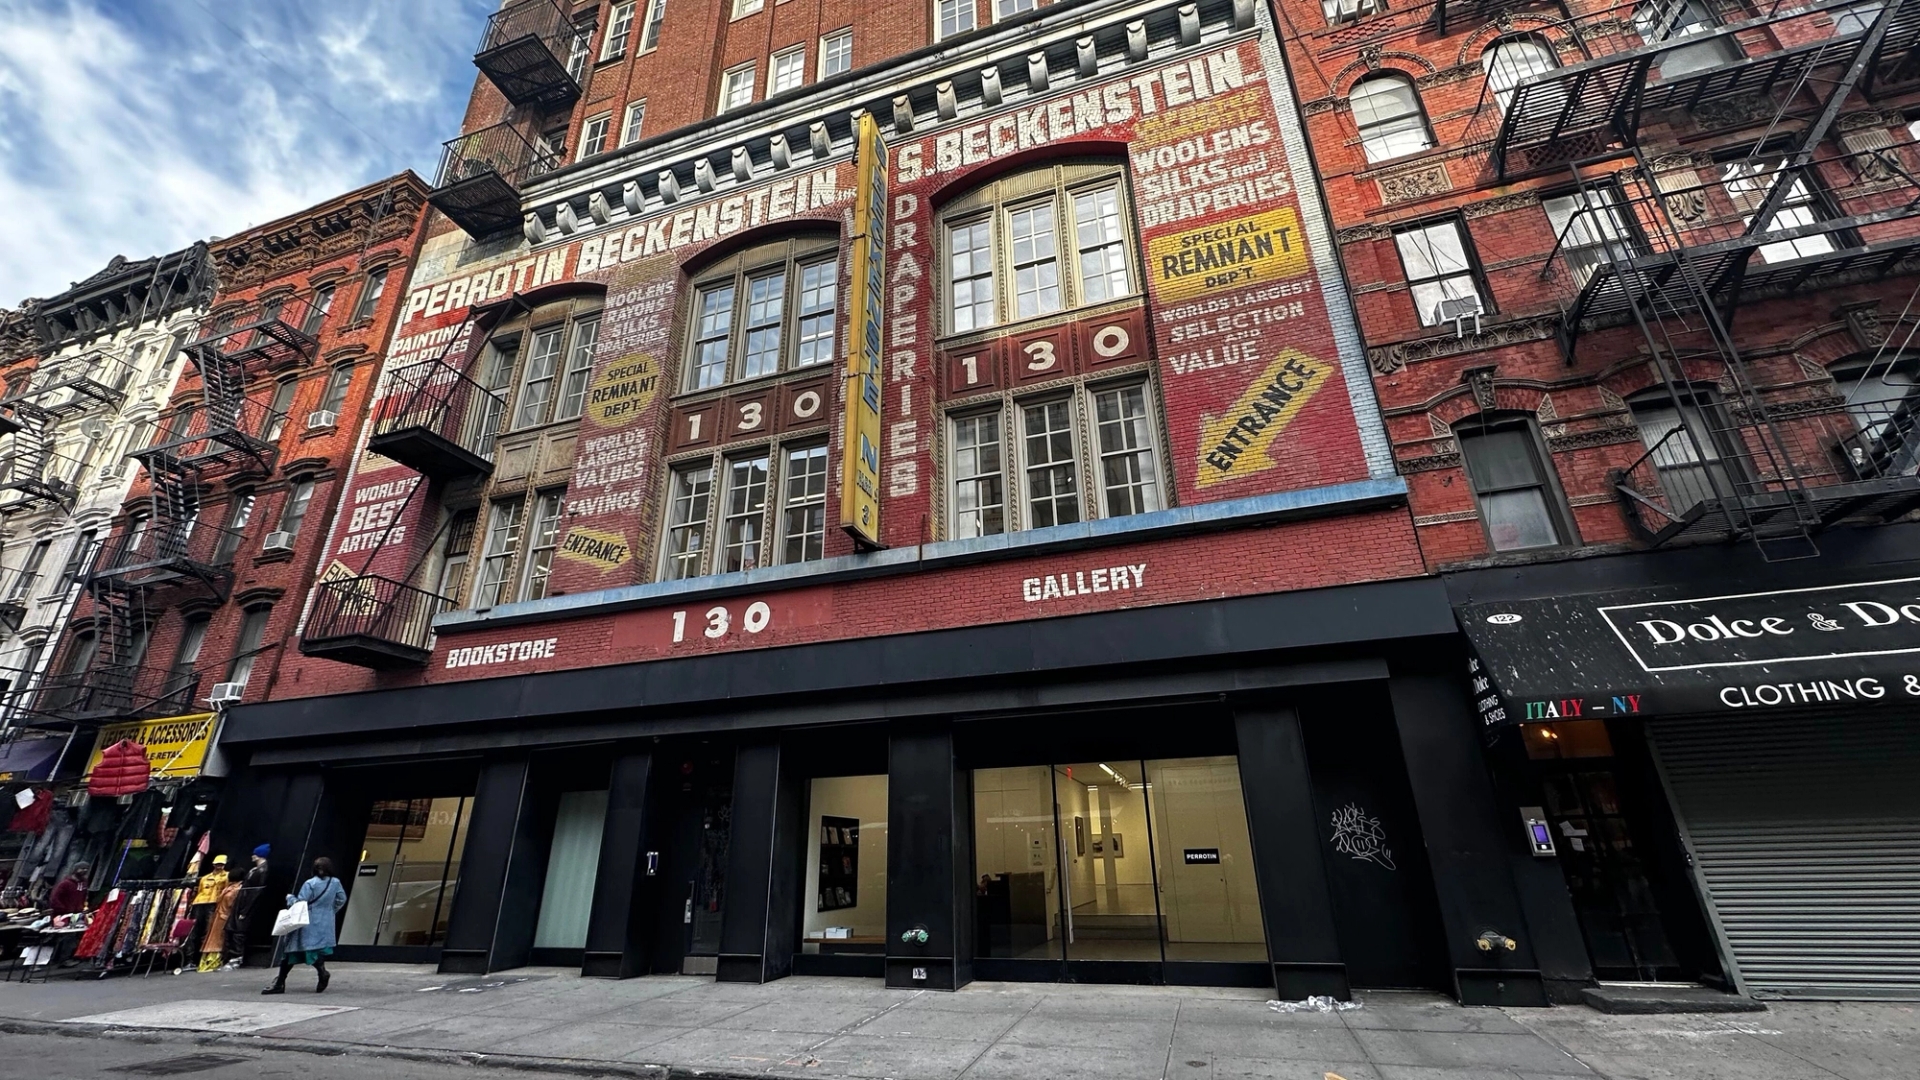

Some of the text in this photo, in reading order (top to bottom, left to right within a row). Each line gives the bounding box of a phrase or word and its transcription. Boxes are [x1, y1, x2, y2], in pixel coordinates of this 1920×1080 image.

[935, 47, 1244, 174] BECKENSTEIN
[1131, 120, 1274, 175] WOOLENS
[1141, 152, 1268, 200] SILKS and
[1143, 172, 1292, 227] DRAPERIES
[403, 249, 571, 324] PERROTIN
[576, 165, 838, 277] BECKENSTEIN
[1182, 221, 1262, 247] SPECIAL
[1162, 227, 1292, 279] REMNANT
[606, 280, 675, 309] WOOLENS
[1234, 280, 1313, 307] LARGEST
[607, 298, 665, 324] RAYONS
[612, 314, 660, 337] SILKS
[1170, 301, 1305, 343] SELECTION
[393, 320, 475, 355] PAINTINGS
[596, 327, 667, 353] DRAPERIES
[889, 193, 922, 497] DRAPERIES
[1224, 328, 1262, 342] AND
[607, 362, 649, 382] SPECIAL
[1168, 340, 1260, 375] VALUE
[591, 375, 658, 404] REMNANT
[1206, 358, 1317, 472] ENTRANCE
[577, 442, 648, 469] LARGEST
[576, 461, 645, 488] VALUES
[348, 498, 405, 534] BEST
[566, 489, 642, 517] SAVINGS
[337, 526, 405, 555] ARTISTS
[561, 532, 629, 565] ENTRANCE
[1023, 563, 1146, 602] GALLERY
[1636, 613, 1795, 645] Dolce
[1807, 612, 1845, 631] &
[445, 637, 558, 669] BOOKSTORE
[1525, 698, 1583, 720] ITALY
[1612, 694, 1642, 715] NY
[1719, 677, 1886, 708] CLOTHING
[1489, 707, 1507, 726] SHOES
[139, 726, 148, 745] &
[145, 721, 211, 745] ACCESSORIES
